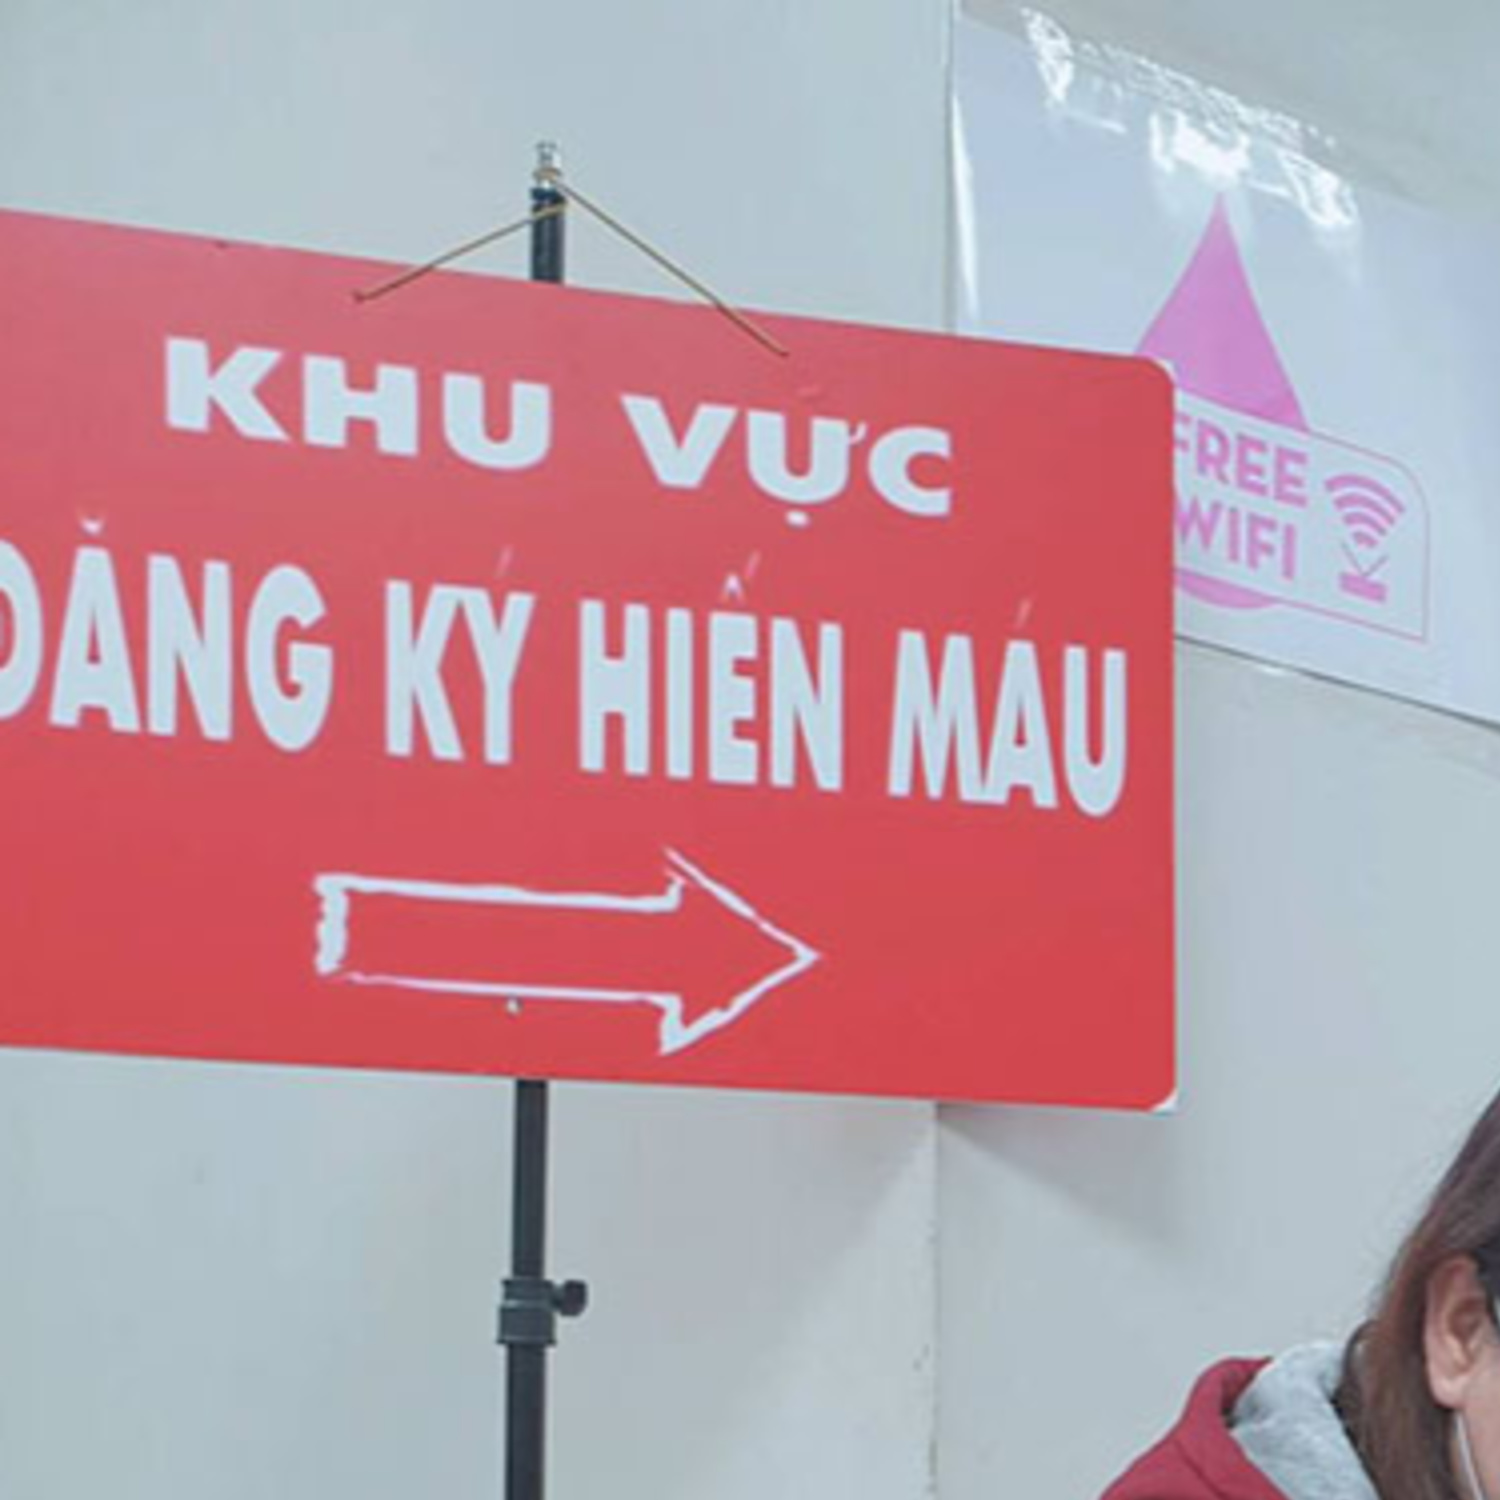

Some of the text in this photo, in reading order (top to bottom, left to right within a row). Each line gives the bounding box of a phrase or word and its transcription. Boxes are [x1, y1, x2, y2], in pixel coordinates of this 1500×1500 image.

[164, 336, 951, 526] KHU VỰC
[1174, 496, 1297, 581] WIFI
[386, 546, 536, 764] KÝ
[579, 551, 844, 792] HIẾN
[889, 599, 1128, 817] MÁU
